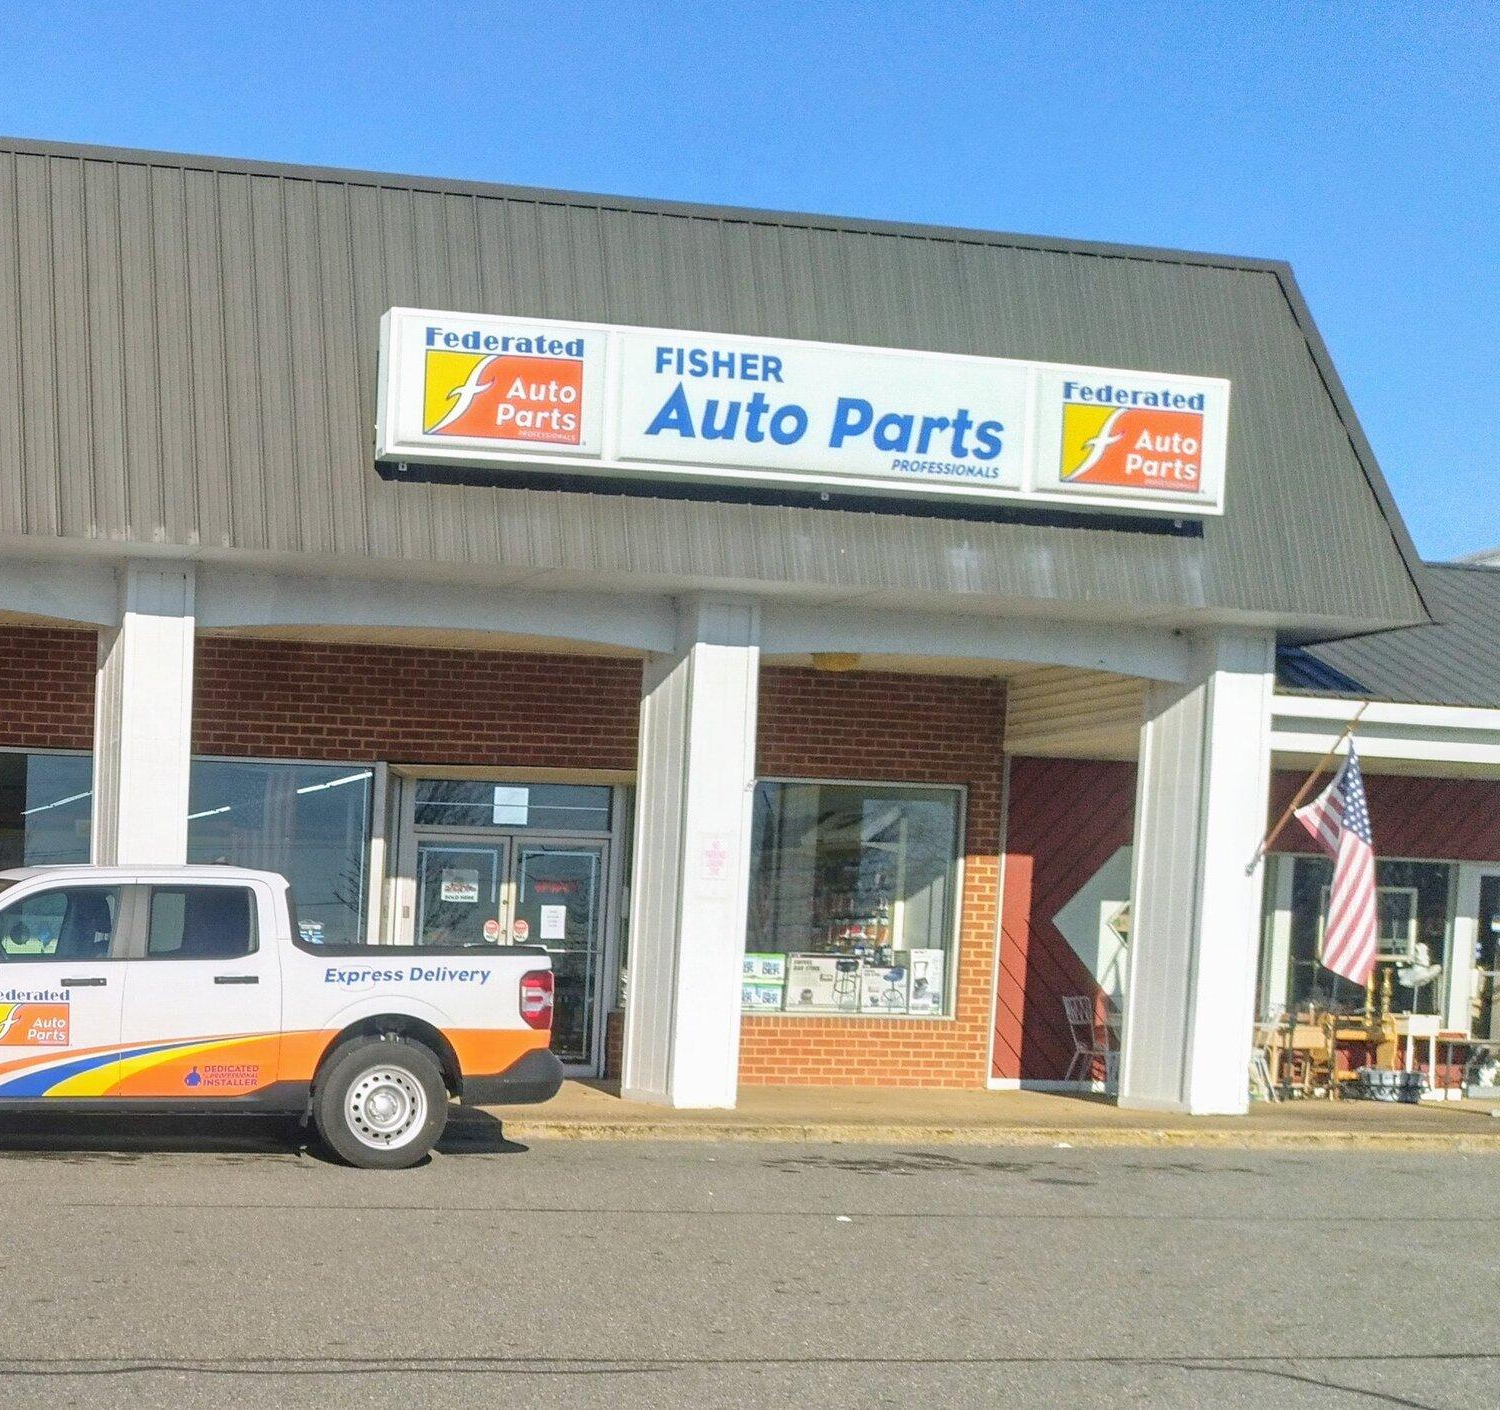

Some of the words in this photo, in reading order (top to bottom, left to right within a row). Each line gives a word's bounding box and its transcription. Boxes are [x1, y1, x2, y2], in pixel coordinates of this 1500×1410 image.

[425, 326, 584, 358] Federated
[655, 346, 784, 383] FISHER
[506, 377, 577, 404] Auto
[1062, 381, 1205, 411] Federated
[496, 403, 576, 431] Parts
[644, 381, 808, 446] Auto
[828, 397, 1004, 461] Parts
[1134, 428, 1198, 456] Auto
[892, 459, 1000, 479] PROFESSIONALS
[1124, 453, 1197, 480] Parts
[324, 968, 404, 986] Express
[409, 966, 491, 985] Delivery
[27, 1029, 66, 1041] Parts
[32, 1017, 66, 1028] Auto
[204, 1065, 260, 1073] DEDICATED
